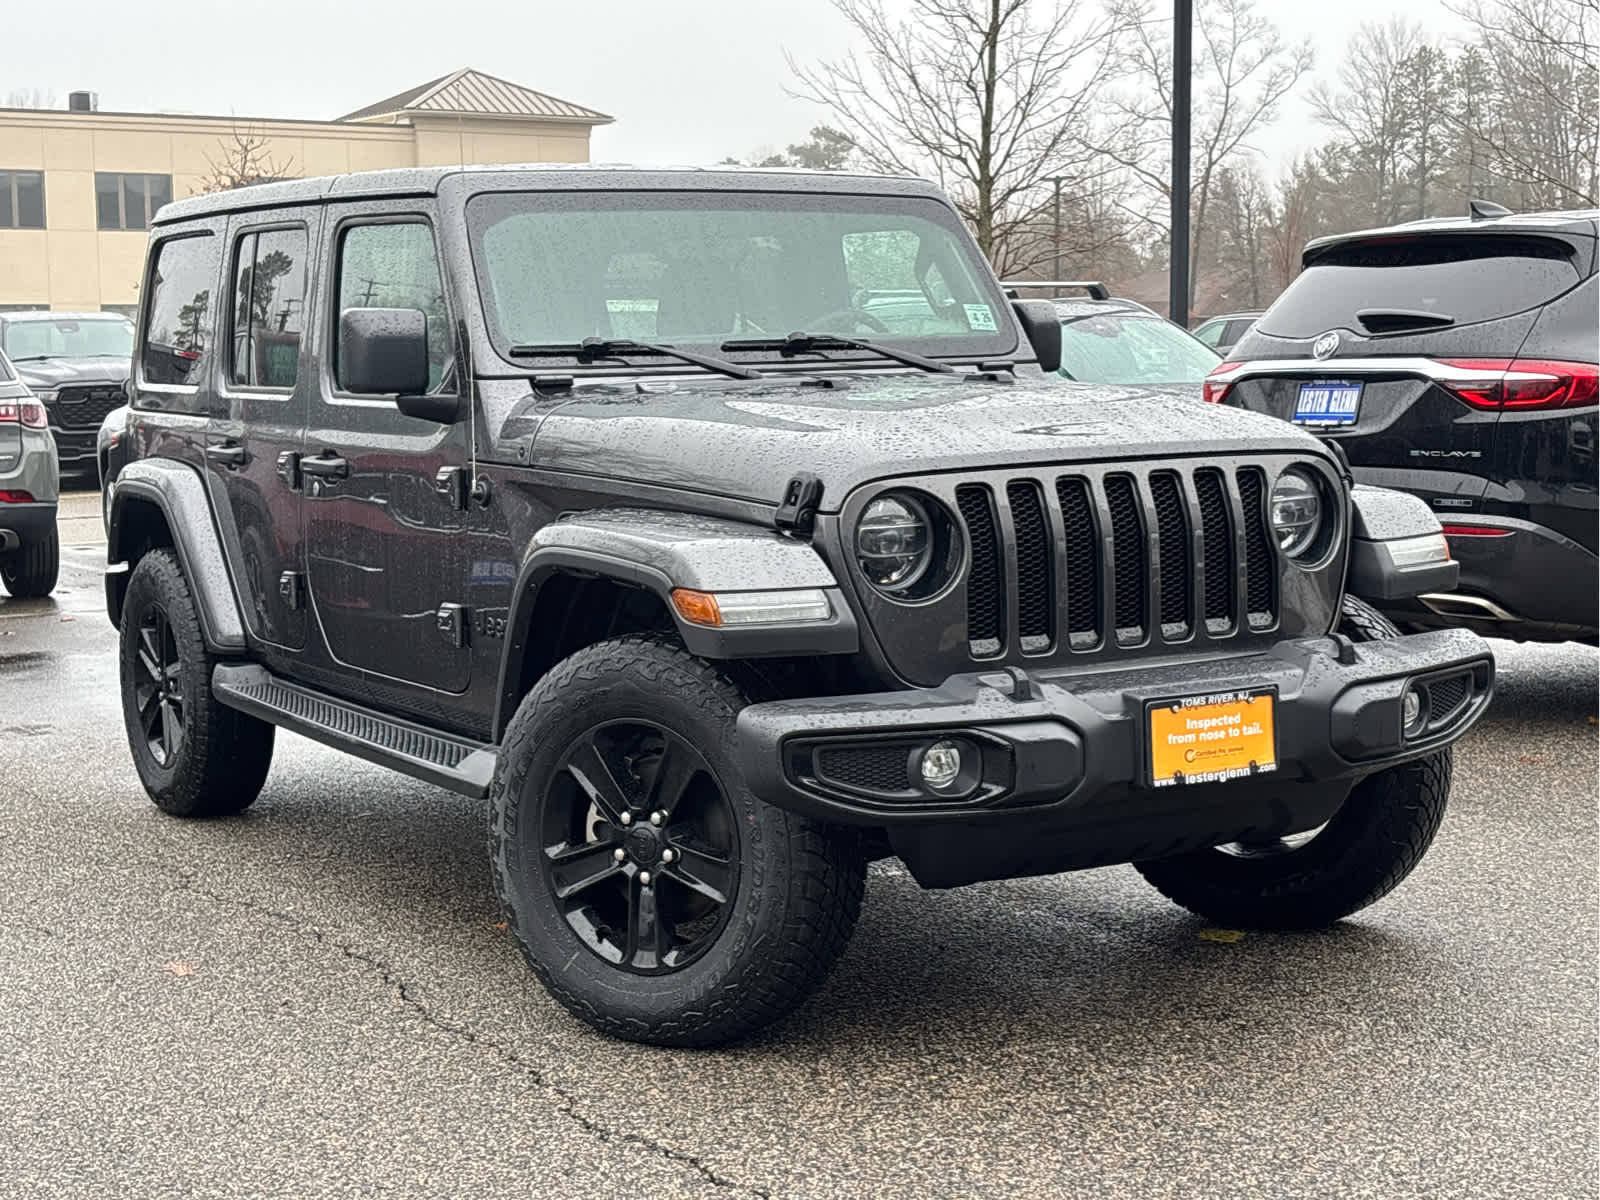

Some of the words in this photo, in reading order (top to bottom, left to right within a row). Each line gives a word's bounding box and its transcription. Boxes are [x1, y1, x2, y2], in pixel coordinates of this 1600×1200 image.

[1297, 390, 1330, 413] LESTER
[1328, 390, 1359, 413] GLENN
[1410, 449, 1481, 458] ENCLAVE
[1181, 697, 1207, 708] TOMS
[1186, 712, 1241, 730] Inspected
[1167, 733, 1196, 745] from
[1199, 729, 1226, 742] nose
[1228, 727, 1240, 738] to
[1242, 722, 1263, 736] tail.
[1153, 778, 1177, 787] www.
[1185, 767, 1250, 785] lesterglenn
[1257, 763, 1276, 773] .com
